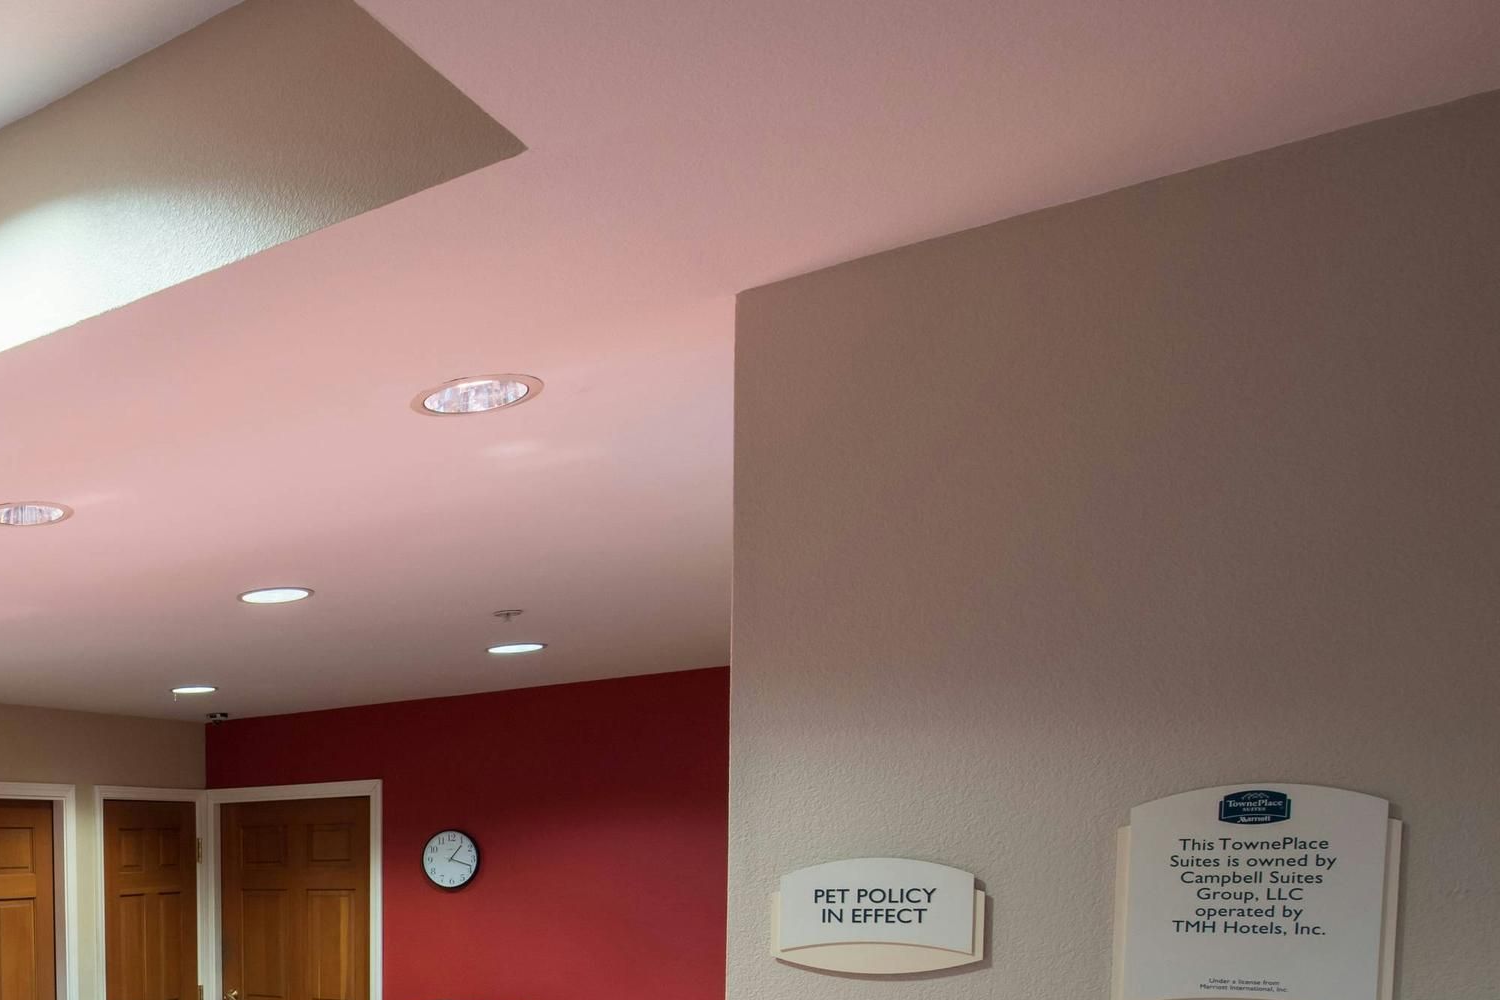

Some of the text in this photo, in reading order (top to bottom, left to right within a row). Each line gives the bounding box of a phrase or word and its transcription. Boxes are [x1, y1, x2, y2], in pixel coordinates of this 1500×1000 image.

[1226, 799, 1284, 808] TownePlace
[438, 836, 444, 845] 11
[448, 833, 456, 841] 12
[1179, 837, 1329, 851] This TownePlace
[1170, 854, 1337, 870] Suites is owned by
[1180, 871, 1324, 886] Campbell Suites
[814, 888, 937, 904] PET POLICY
[1196, 887, 1304, 903] Group, LLC
[821, 908, 928, 924] IN EFFECT
[1195, 905, 1304, 921] operated by
[1172, 920, 1326, 936] TMH Hotels, Inc.
